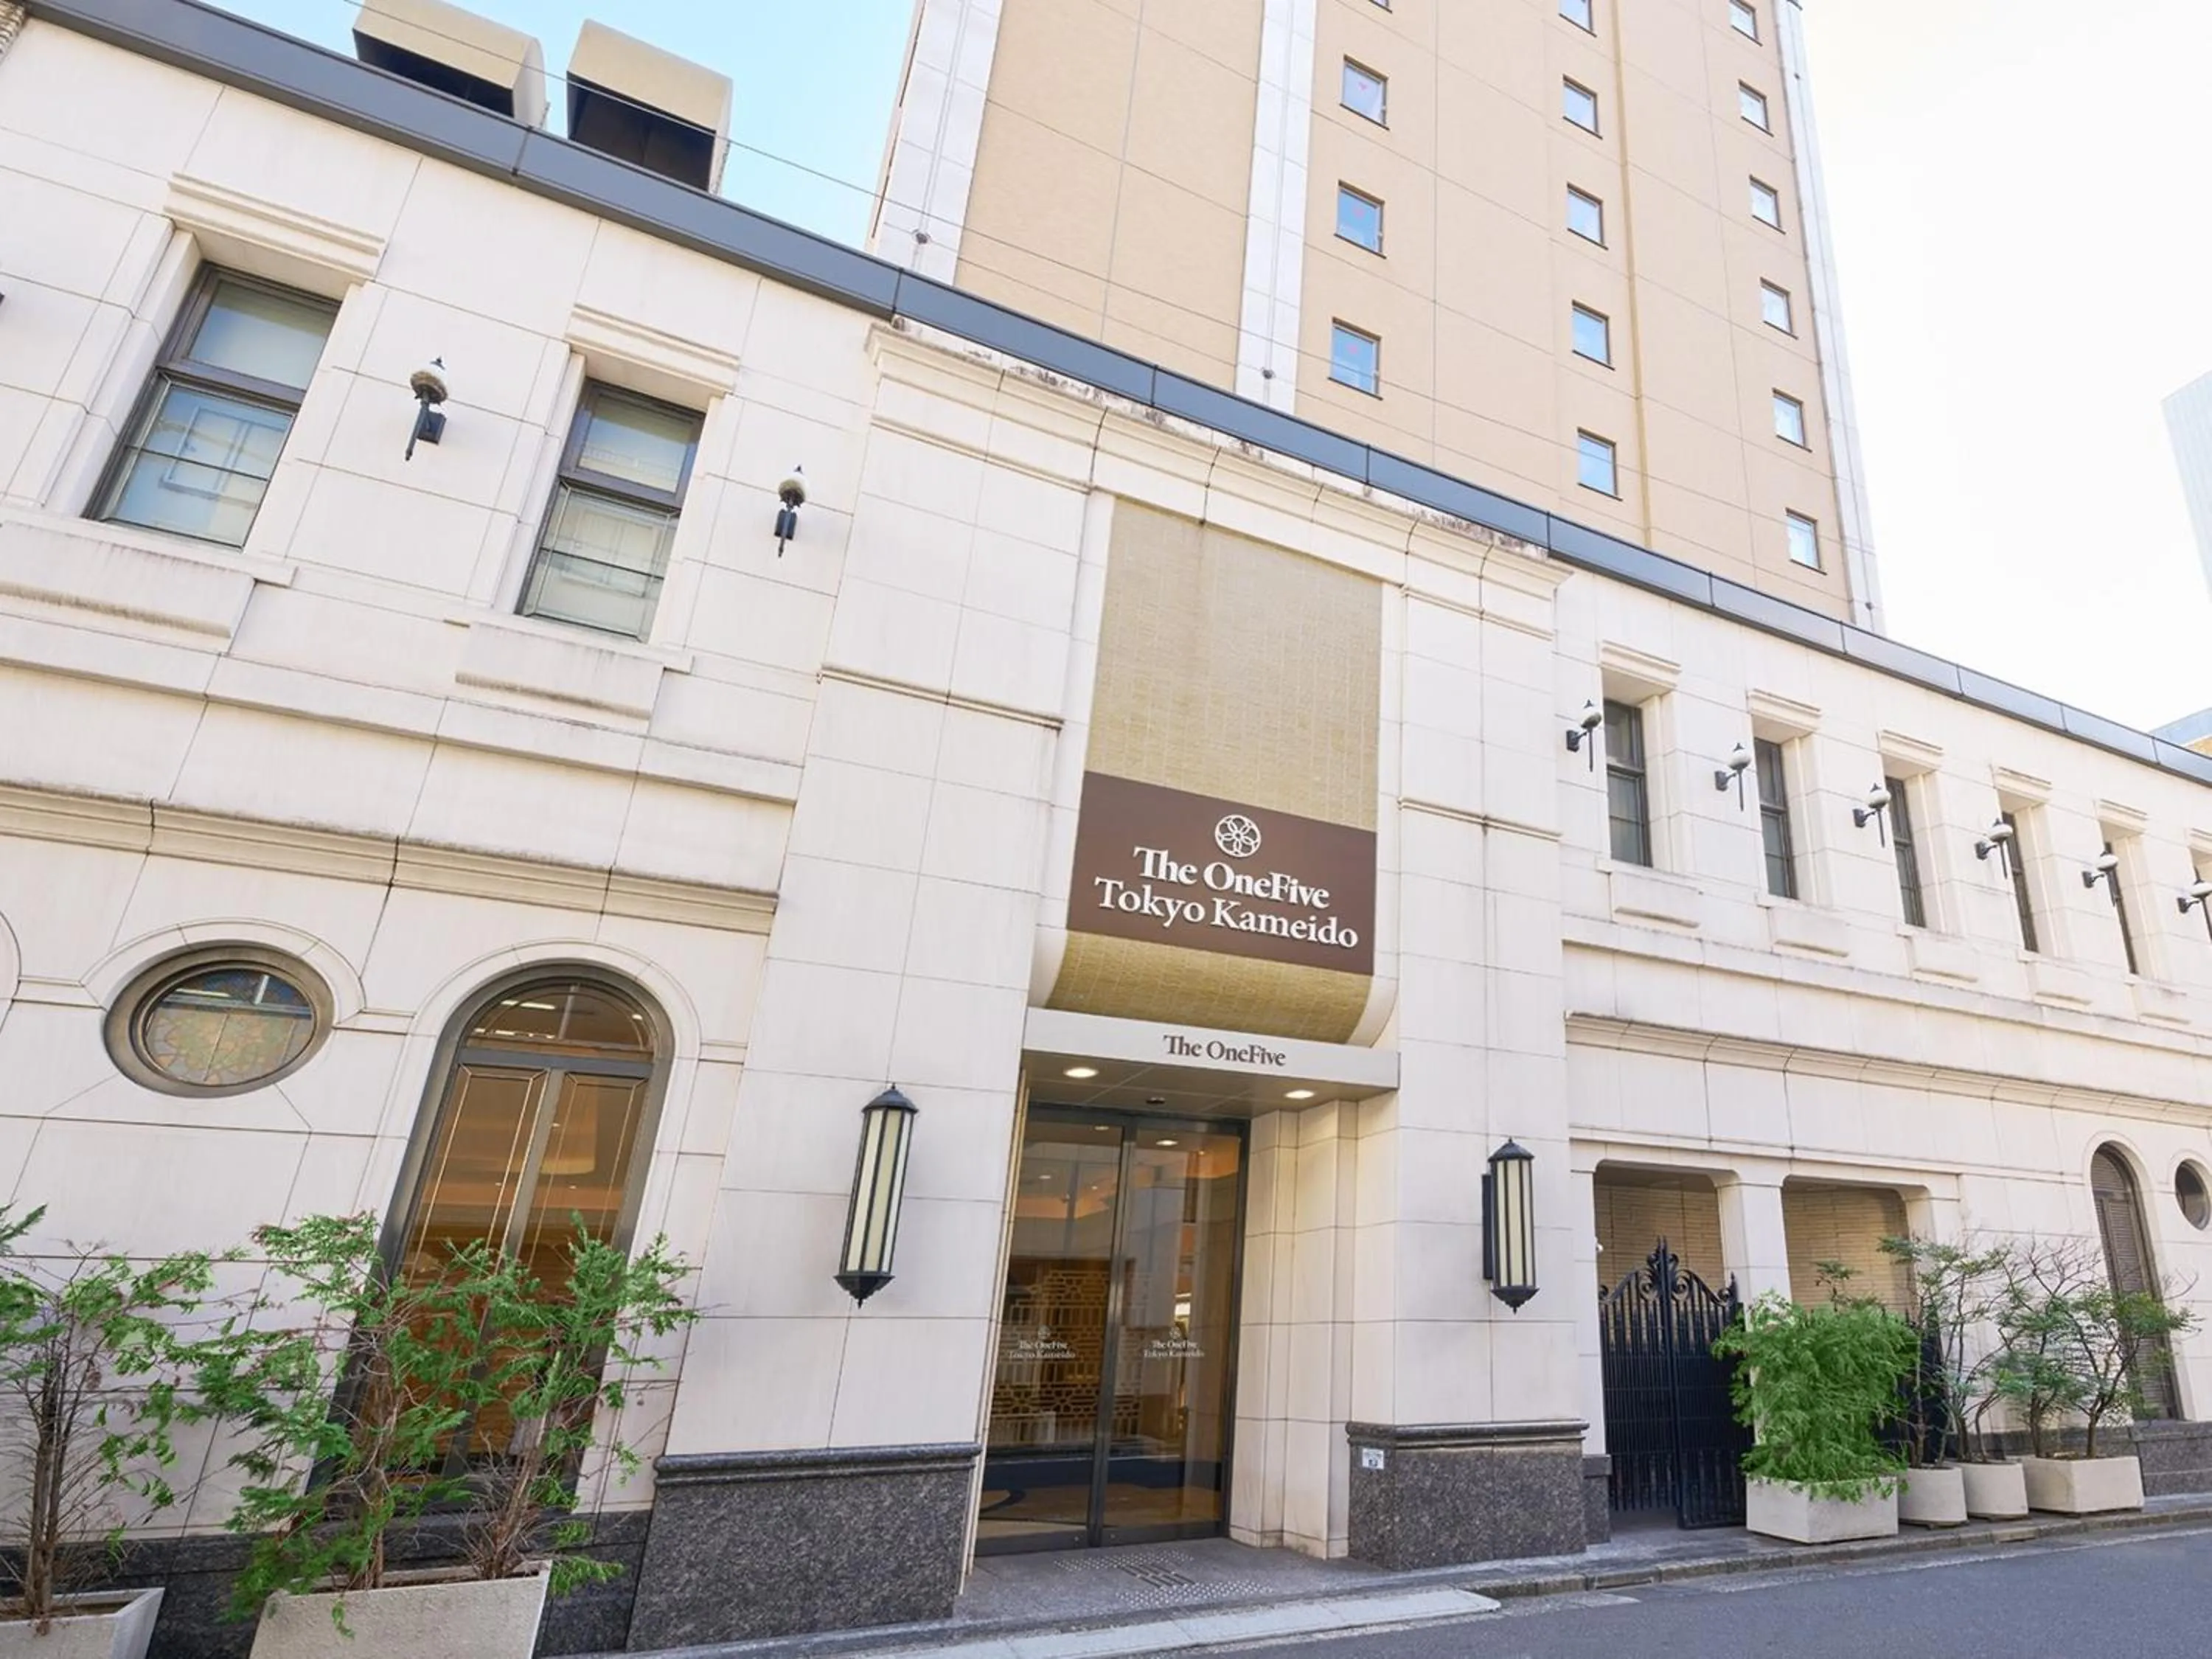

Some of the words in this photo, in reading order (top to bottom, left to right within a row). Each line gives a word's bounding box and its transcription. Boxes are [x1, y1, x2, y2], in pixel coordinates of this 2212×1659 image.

[1133, 846, 1197, 885] The
[1203, 861, 1330, 909] OneFive
[1094, 876, 1206, 928] Tokyo
[1210, 897, 1359, 948] Kameido
[1163, 1034, 1202, 1057] The
[1206, 1040, 1286, 1067] OneFive
